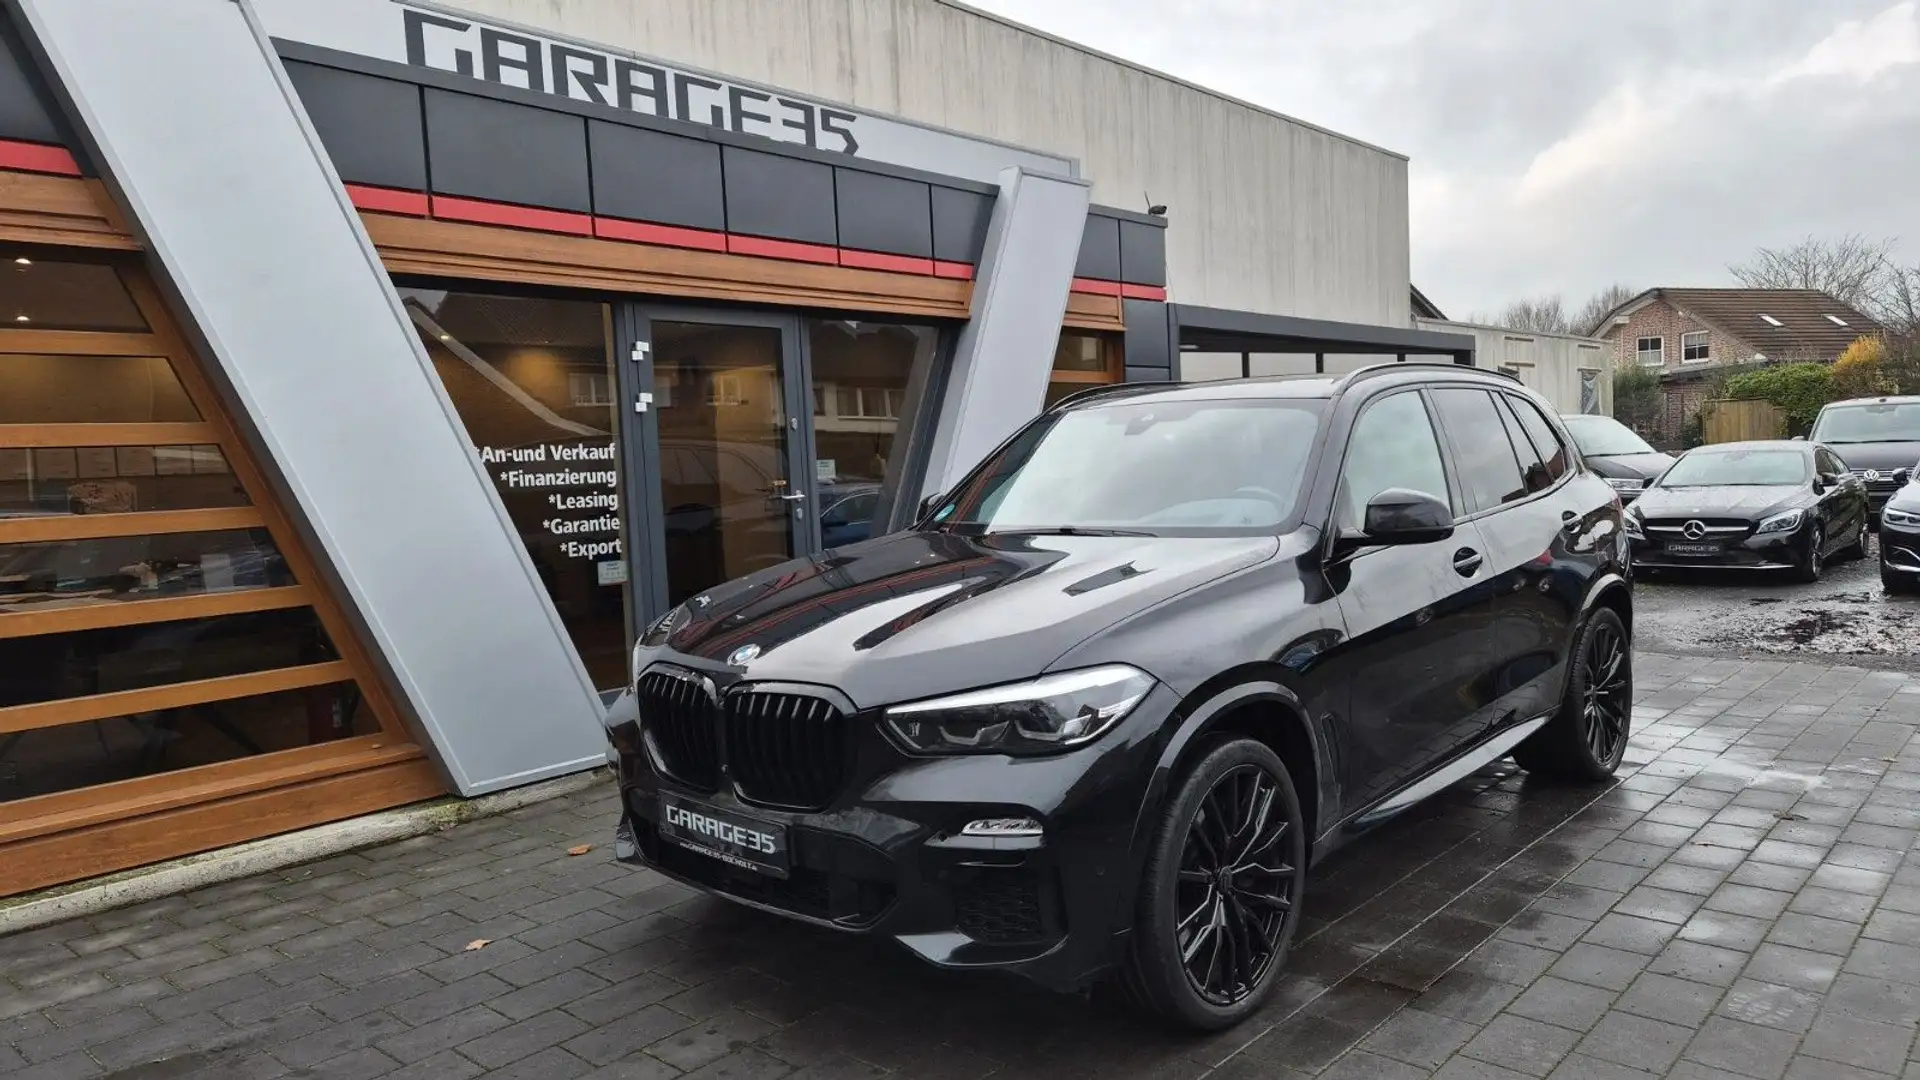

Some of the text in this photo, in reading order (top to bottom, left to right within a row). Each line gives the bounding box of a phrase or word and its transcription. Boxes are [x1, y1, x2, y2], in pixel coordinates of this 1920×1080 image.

[403, 8, 859, 157] GARAGE35
[550, 442, 616, 462] Verkauf
[665, 804, 777, 855] GARAGE35
